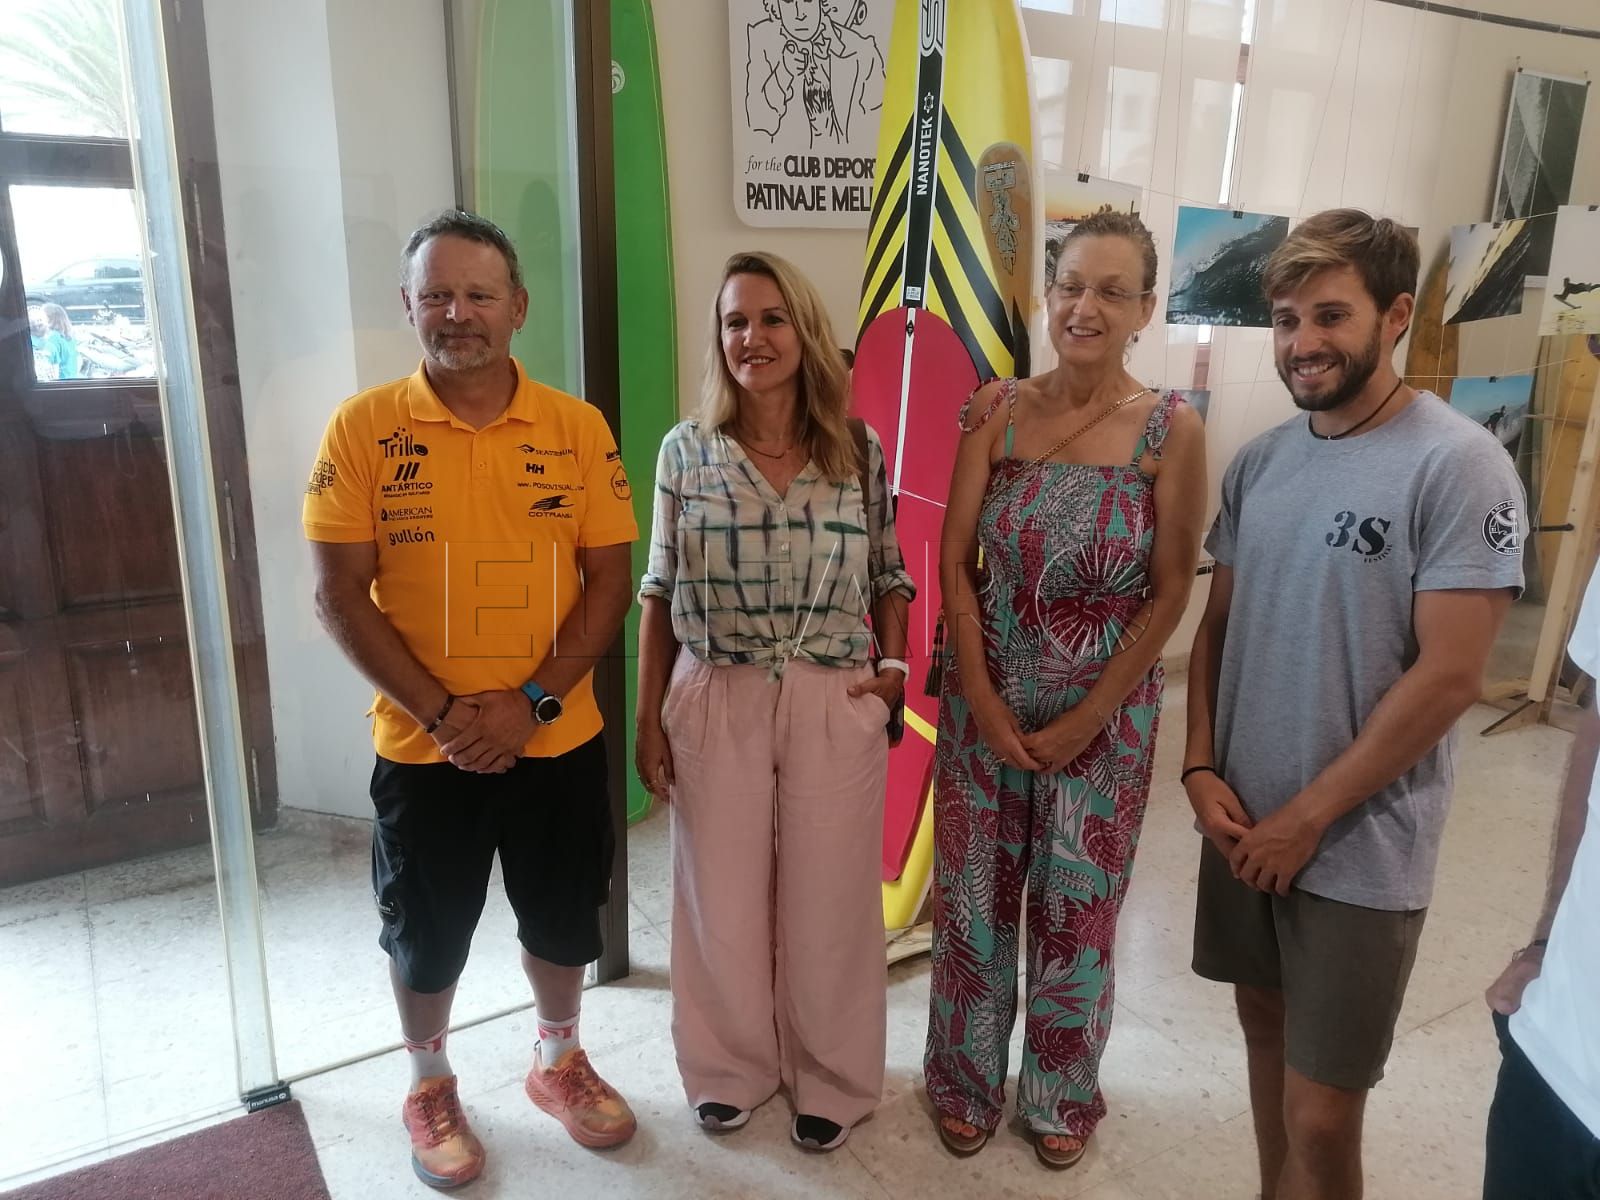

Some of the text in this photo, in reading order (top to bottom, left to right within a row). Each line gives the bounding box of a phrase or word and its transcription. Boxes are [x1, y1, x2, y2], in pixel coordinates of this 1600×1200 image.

[745, 155, 762, 174] for
[765, 156, 782, 171] the
[784, 155, 821, 178] CLUB
[916, 116, 933, 196] NANOTEK
[746, 182, 827, 211] PATINAJE
[526, 462, 545, 475] HH
[381, 482, 433, 492] ANTÁRTICO
[388, 506, 433, 517] AMERICAN
[389, 526, 435, 546] gullón
[1325, 510, 1391, 556] 3S
